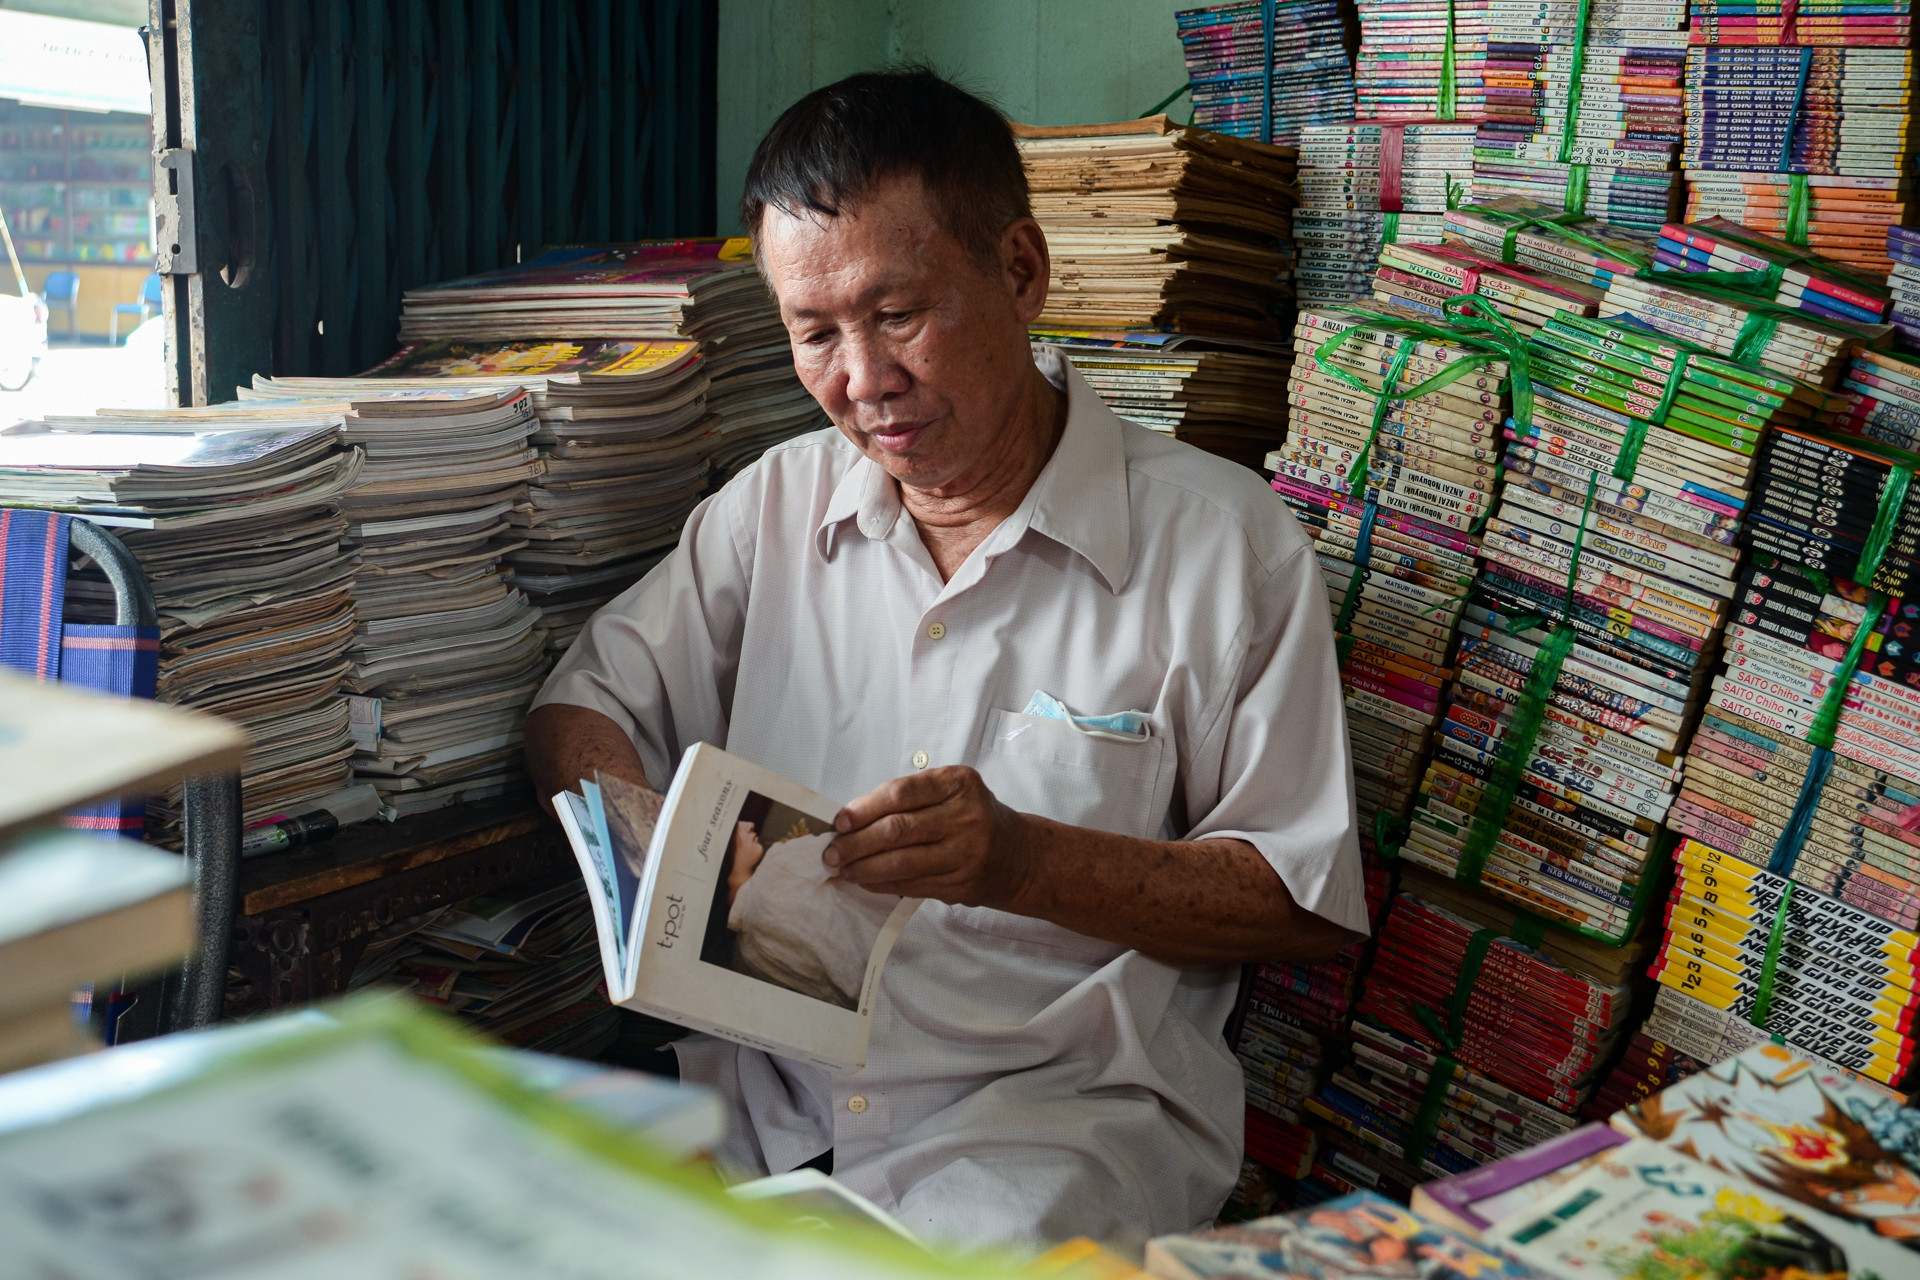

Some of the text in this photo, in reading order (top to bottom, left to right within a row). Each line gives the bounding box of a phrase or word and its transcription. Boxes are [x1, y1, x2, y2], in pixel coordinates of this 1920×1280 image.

[1871, 412, 1918, 439] BEYOND
[1867, 423, 1914, 450] BEYOND
[1406, 472, 1463, 498] ANZAI Nobuyuki
[1402, 484, 1460, 509] ANZAI Nobuyuki
[1385, 495, 1443, 520] Nobuyuki ANZAI
[1395, 567, 1406, 576] 4
[1401, 557, 1412, 567] 5
[1383, 579, 1426, 597] MATSURI HINO
[1376, 592, 1419, 611] MATSURI HINO
[1763, 598, 1813, 623] KENTARO YABUKI
[1373, 607, 1416, 626] MATSURI HINO
[1611, 622, 1625, 633] 2
[1757, 617, 1807, 642] KENTARO YABUKI
[1747, 647, 1805, 673] Mayumi MUROYAMA
[1749, 662, 1808, 688] Mayumi MUROYAMA
[1736, 670, 1813, 705] SAITO Chiho 1
[1721, 681, 1798, 718] SAITO Chiho 2
[1719, 697, 1796, 734] SAITO Chiho 3
[1443, 739, 1458, 750] Tada
[1618, 739, 1642, 753] THANH
[697, 780, 732, 863] four seasons
[1579, 813, 1592, 822] Lee
[1516, 811, 1583, 846] and clover
[1709, 851, 1721, 864] 12
[1582, 870, 1605, 884] THANH
[1701, 863, 1715, 875] 10
[1545, 865, 1563, 879] NXB
[1617, 895, 1631, 905] Tin
[1704, 876, 1717, 888] 9
[1704, 893, 1718, 904] 8
[1694, 918, 1707, 928] 5
[1702, 907, 1715, 919] 7
[1862, 916, 1894, 938] UP
[1691, 932, 1704, 944] 6
[1854, 928, 1885, 950] UP
[1687, 960, 1701, 973] 3
[1858, 957, 1889, 979] UP
[1681, 981, 1694, 990] 1
[1687, 974, 1702, 986] 2
[1855, 972, 1887, 994] UP
[1659, 997, 1719, 1029] Narumi Kakinouchi
[1663, 988, 1723, 1020] Narumi Kakinouchi
[1653, 1018, 1712, 1050] Narumi Kakinouchi
[1648, 1057, 1659, 1070] 9
[1648, 1074, 1660, 1086] 8
